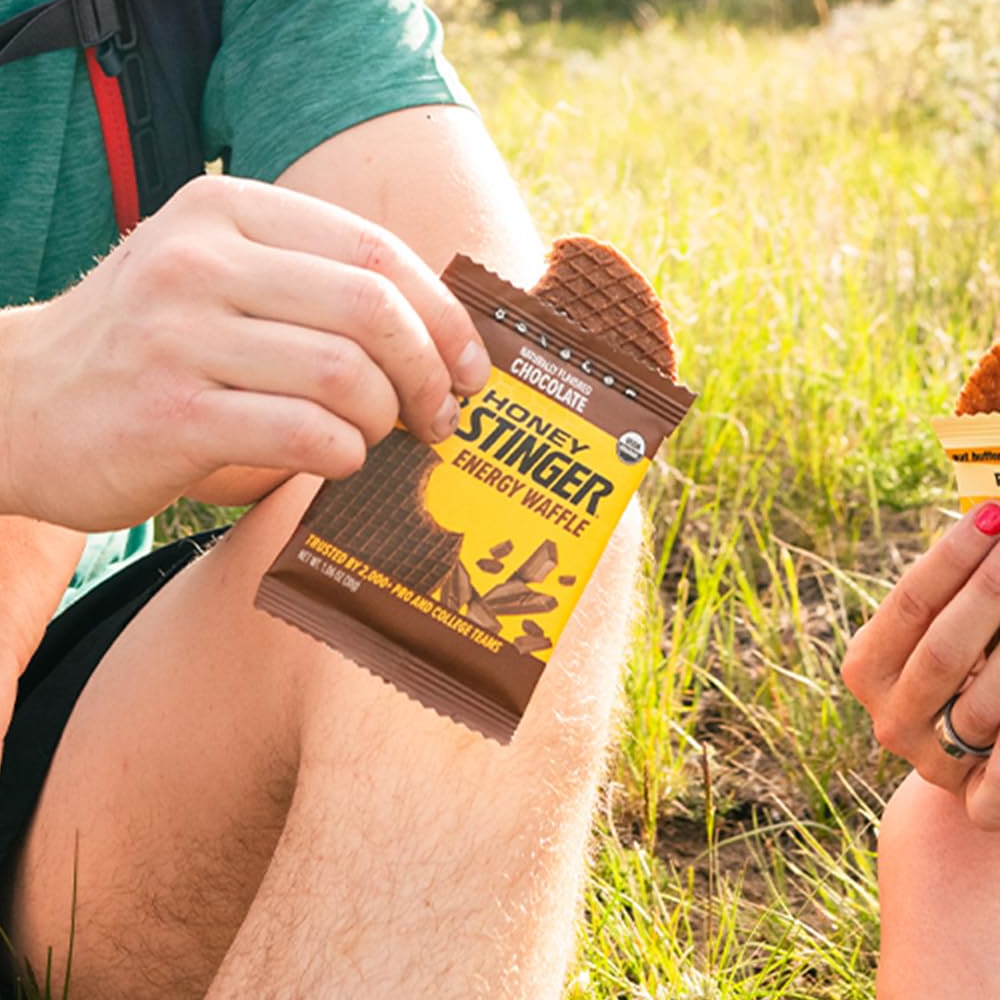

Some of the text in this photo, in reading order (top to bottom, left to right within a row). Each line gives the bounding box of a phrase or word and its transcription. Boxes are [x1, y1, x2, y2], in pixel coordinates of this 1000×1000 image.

[482, 389, 590, 455] HONEY
[510, 358, 589, 413] CHOCOLATE
[452, 449, 591, 538] ENERGY WAFFLE
[454, 406, 615, 517] STINGER
[304, 533, 348, 565] TRUSTED
[344, 556, 363, 572] BY
[390, 583, 415, 602] PRO
[409, 595, 434, 614] AND
[431, 606, 474, 637] COLLEGE
[469, 628, 503, 654] TEAMS
